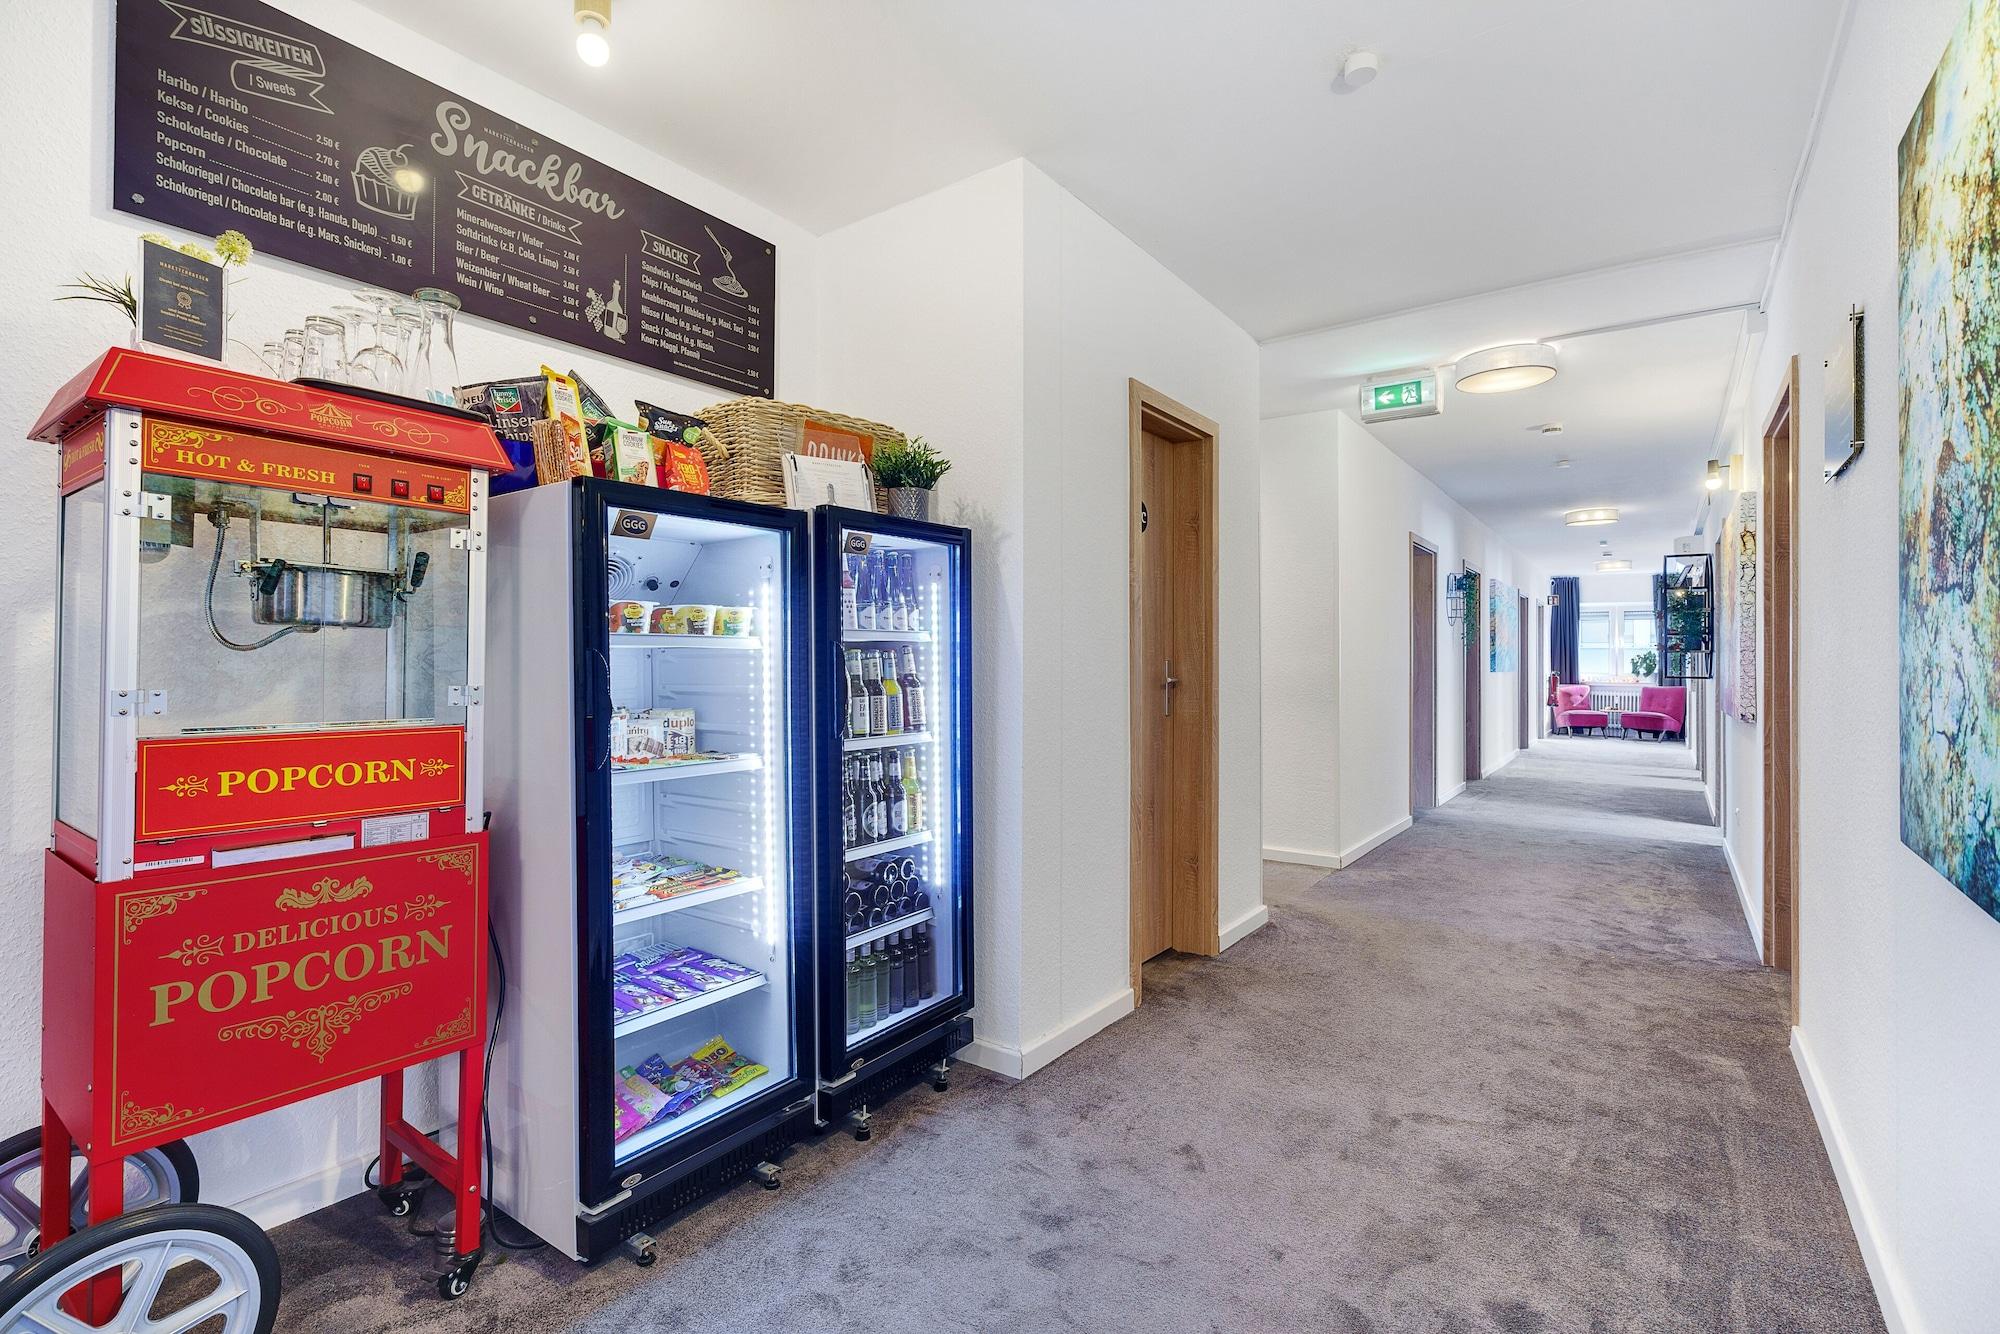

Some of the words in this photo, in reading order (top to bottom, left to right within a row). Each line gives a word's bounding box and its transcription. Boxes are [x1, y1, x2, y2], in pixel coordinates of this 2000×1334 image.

[190, 15, 314, 66] SÜSSIGKEITEN
[256, 76, 297, 97] Sweets
[158, 69, 199, 95] Haribo
[210, 89, 249, 114] Haribo
[316, 134, 333, 148] 2.50
[158, 90, 194, 113] Kekse
[205, 108, 249, 134] Cookies
[316, 153, 333, 166] 2.70
[157, 111, 225, 145] Schokolade
[235, 140, 287, 167] Chocolate
[316, 171, 333, 185] 2.00
[430, 101, 625, 220] Snackbar
[157, 131, 206, 159] Popcorn
[315, 190, 333, 204] 2.00
[156, 152, 224, 185] Schokoriegel
[232, 177, 278, 203] Chocolate
[280, 194, 295, 208] bar
[298, 200, 317, 218] (e.g.
[319, 207, 350, 228] Hanuta,
[352, 218, 378, 238] Duplo)
[391, 234, 406, 246] 0.50
[472, 184, 535, 221] GETRÄNKE
[543, 216, 566, 232] Drinks
[155, 174, 223, 209] Schokoriegel
[232, 199, 277, 224] Chocolate
[280, 214, 295, 229] bar
[297, 220, 316, 238] (e.g.
[318, 227, 342, 246] Mars,
[344, 236, 382, 258] Snickers)
[392, 254, 406, 265] 1.00
[457, 208, 516, 238] Mineralwasser
[522, 232, 544, 249] Water
[456, 224, 498, 247] Softdrinks
[500, 240, 517, 254] (z.B.
[519, 247, 537, 262] Cola,
[539, 255, 559, 270] Limo)
[456, 240, 474, 256] Bier
[481, 249, 499, 264] Beer
[653, 241, 688, 265] SNACKS
[456, 257, 501, 282] Weizenbier
[508, 273, 531, 292] Wheat
[533, 282, 550, 297] Beer
[456, 272, 478, 289] Wein
[484, 281, 504, 297] Wine
[642, 261, 670, 279] Sandwich
[675, 274, 702, 292] Sandwich
[642, 274, 659, 288] Chips
[664, 282, 681, 296] Potato
[682, 290, 698, 304] Chips
[641, 305, 660, 319] Nüsse
[665, 313, 678, 325] Nuts
[642, 290, 680, 313] Knabberzeug
[684, 305, 705, 320] Nibbles
[641, 320, 660, 335] Snack
[665, 328, 682, 342] Snack
[463, 395, 484, 404] NEU
[311, 413, 353, 428] POPCORN
[659, 417, 672, 425] Sun
[176, 449, 231, 469] HOT
[237, 459, 256, 473] &
[262, 462, 336, 485] FRESH
[623, 518, 646, 531] GGG
[851, 539, 865, 550] GGG
[663, 717, 694, 730] duplo
[216, 758, 417, 797] POPCORN
[233, 904, 399, 954] DELICIOUS
[149, 925, 453, 1028] POPCORN
